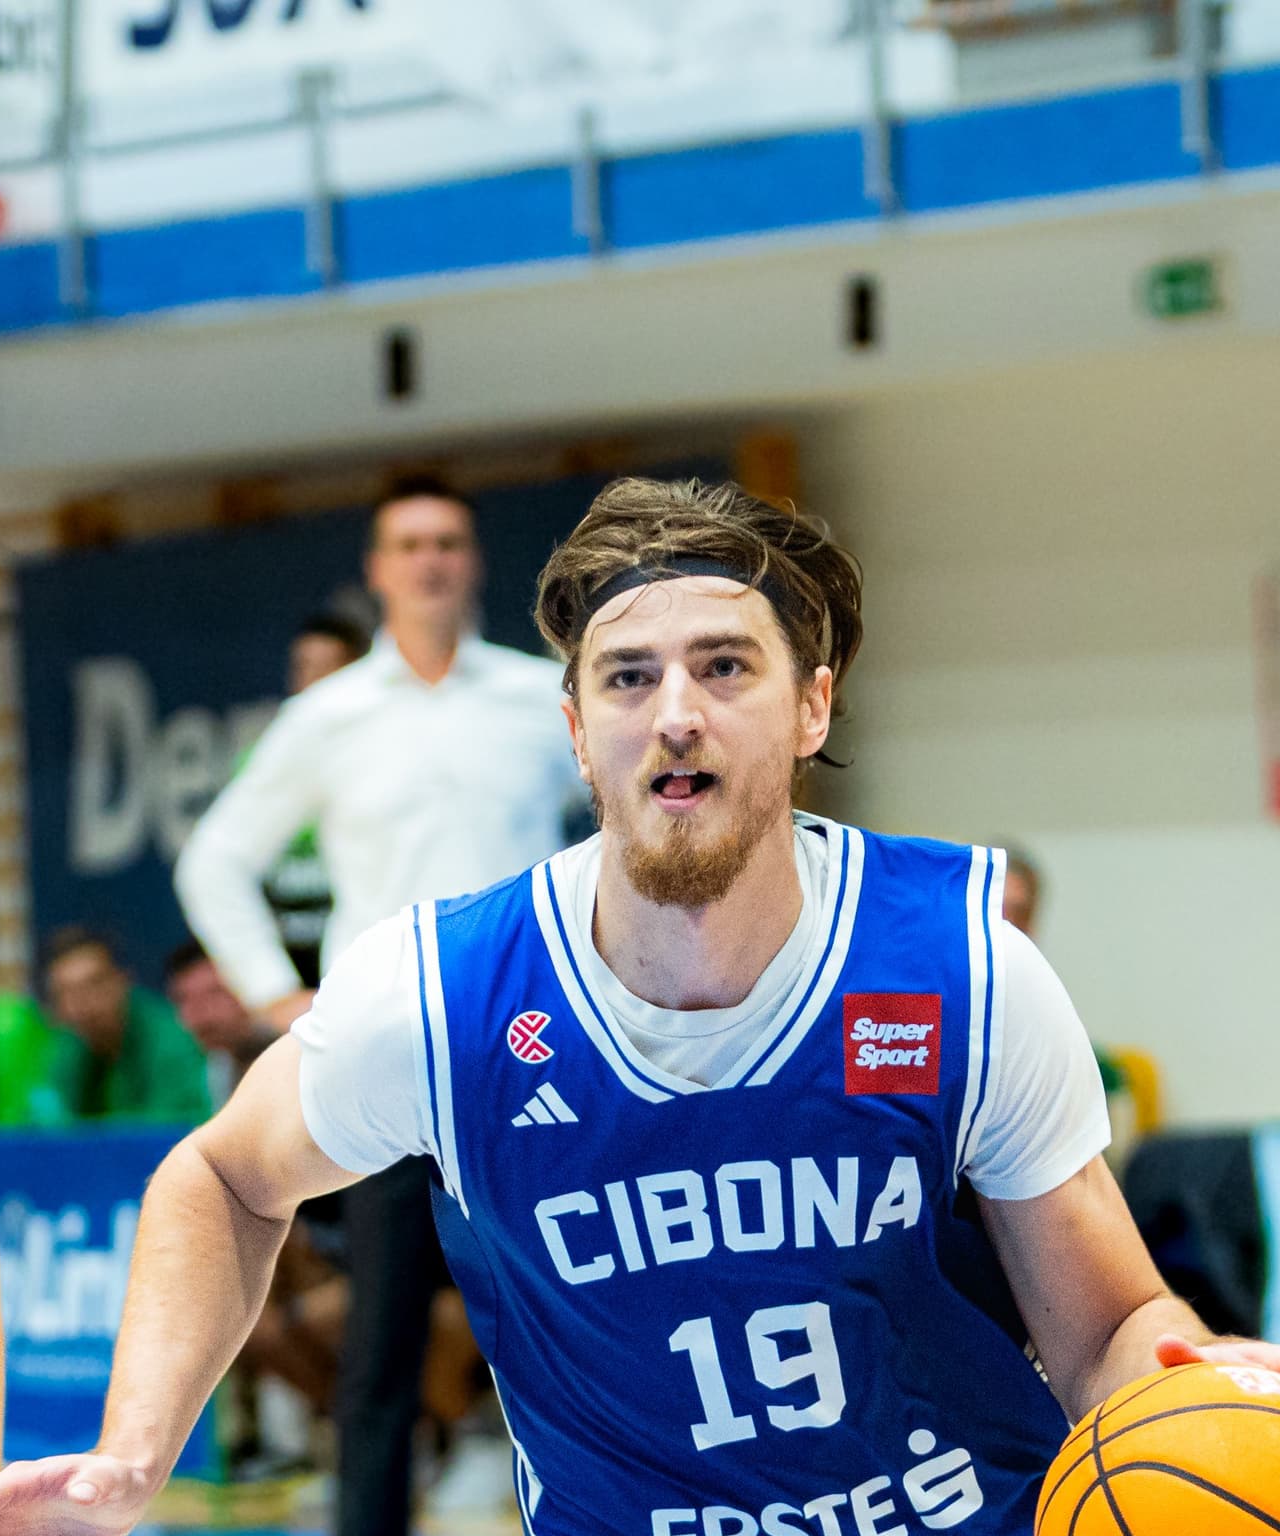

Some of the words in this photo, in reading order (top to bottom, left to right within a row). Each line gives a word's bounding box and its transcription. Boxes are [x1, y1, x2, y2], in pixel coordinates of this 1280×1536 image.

[850, 1018, 933, 1043] Super
[855, 1044, 929, 1069] Sport
[534, 1156, 924, 1284] CIBONA
[668, 1301, 846, 1452] 19
